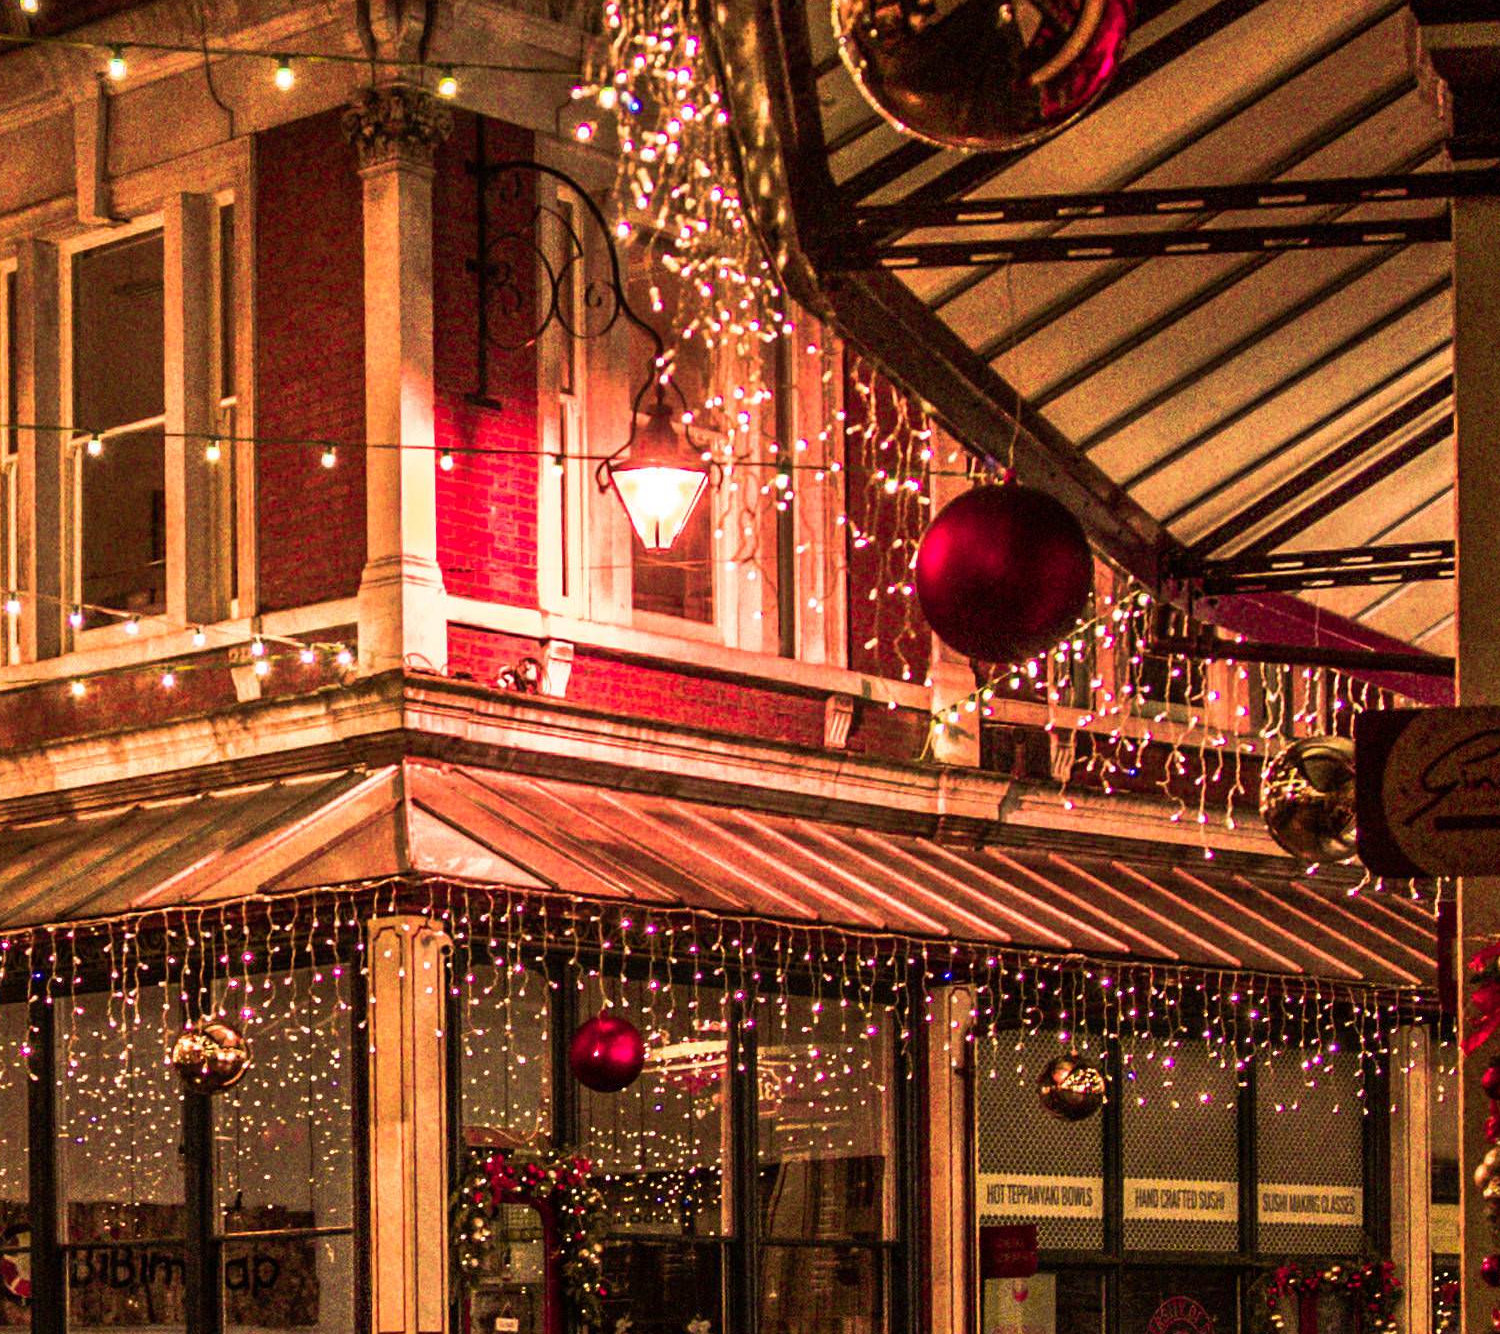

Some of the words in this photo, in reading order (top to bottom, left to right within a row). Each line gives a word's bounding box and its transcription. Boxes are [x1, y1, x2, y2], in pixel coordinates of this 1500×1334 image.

[986, 1183, 1005, 1205] HOT
[1007, 1184, 1060, 1207] TEPPANYAKI
[1061, 1185, 1093, 1208] BOWLS
[1134, 1188, 1159, 1210] HAND
[1160, 1189, 1198, 1210] CRAFTED
[1198, 1190, 1226, 1211] SUSHI
[1262, 1193, 1287, 1213] SUSHI
[1287, 1193, 1320, 1214] MAKING
[1320, 1194, 1356, 1215] CLASSES
[71, 1245, 281, 1299] BiBimap
